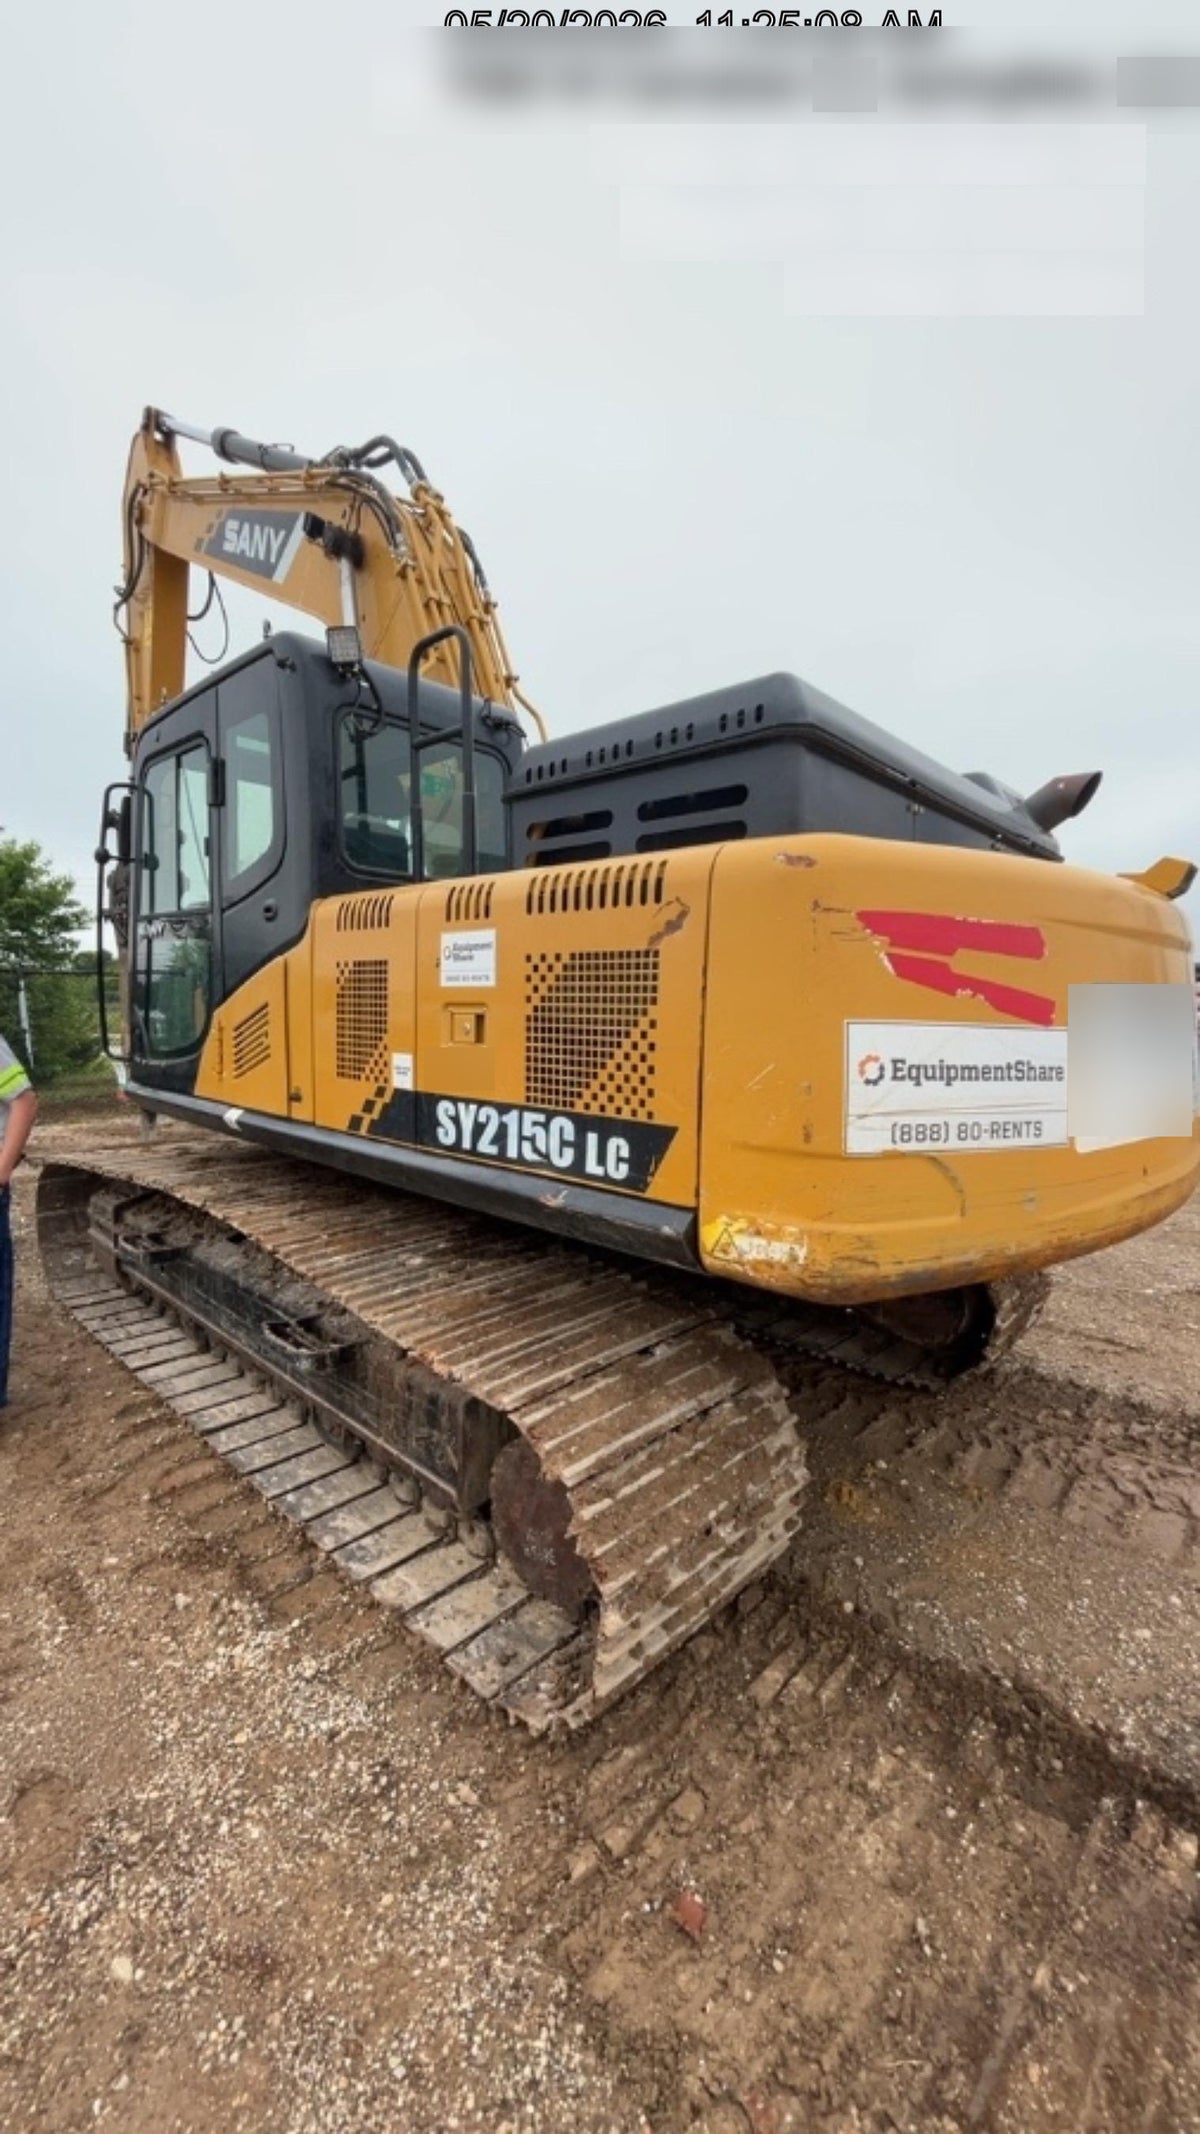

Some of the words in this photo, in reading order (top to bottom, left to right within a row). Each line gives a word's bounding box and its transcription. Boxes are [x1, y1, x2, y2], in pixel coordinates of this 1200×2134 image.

[222, 519, 286, 564] SANY
[890, 1058, 1064, 1086] EquipmentShare
[436, 1099, 575, 1169] SY215C
[585, 1131, 630, 1180] LC
[891, 1121, 950, 1145] (888)
[957, 1121, 1043, 1142] 80-RENTS
